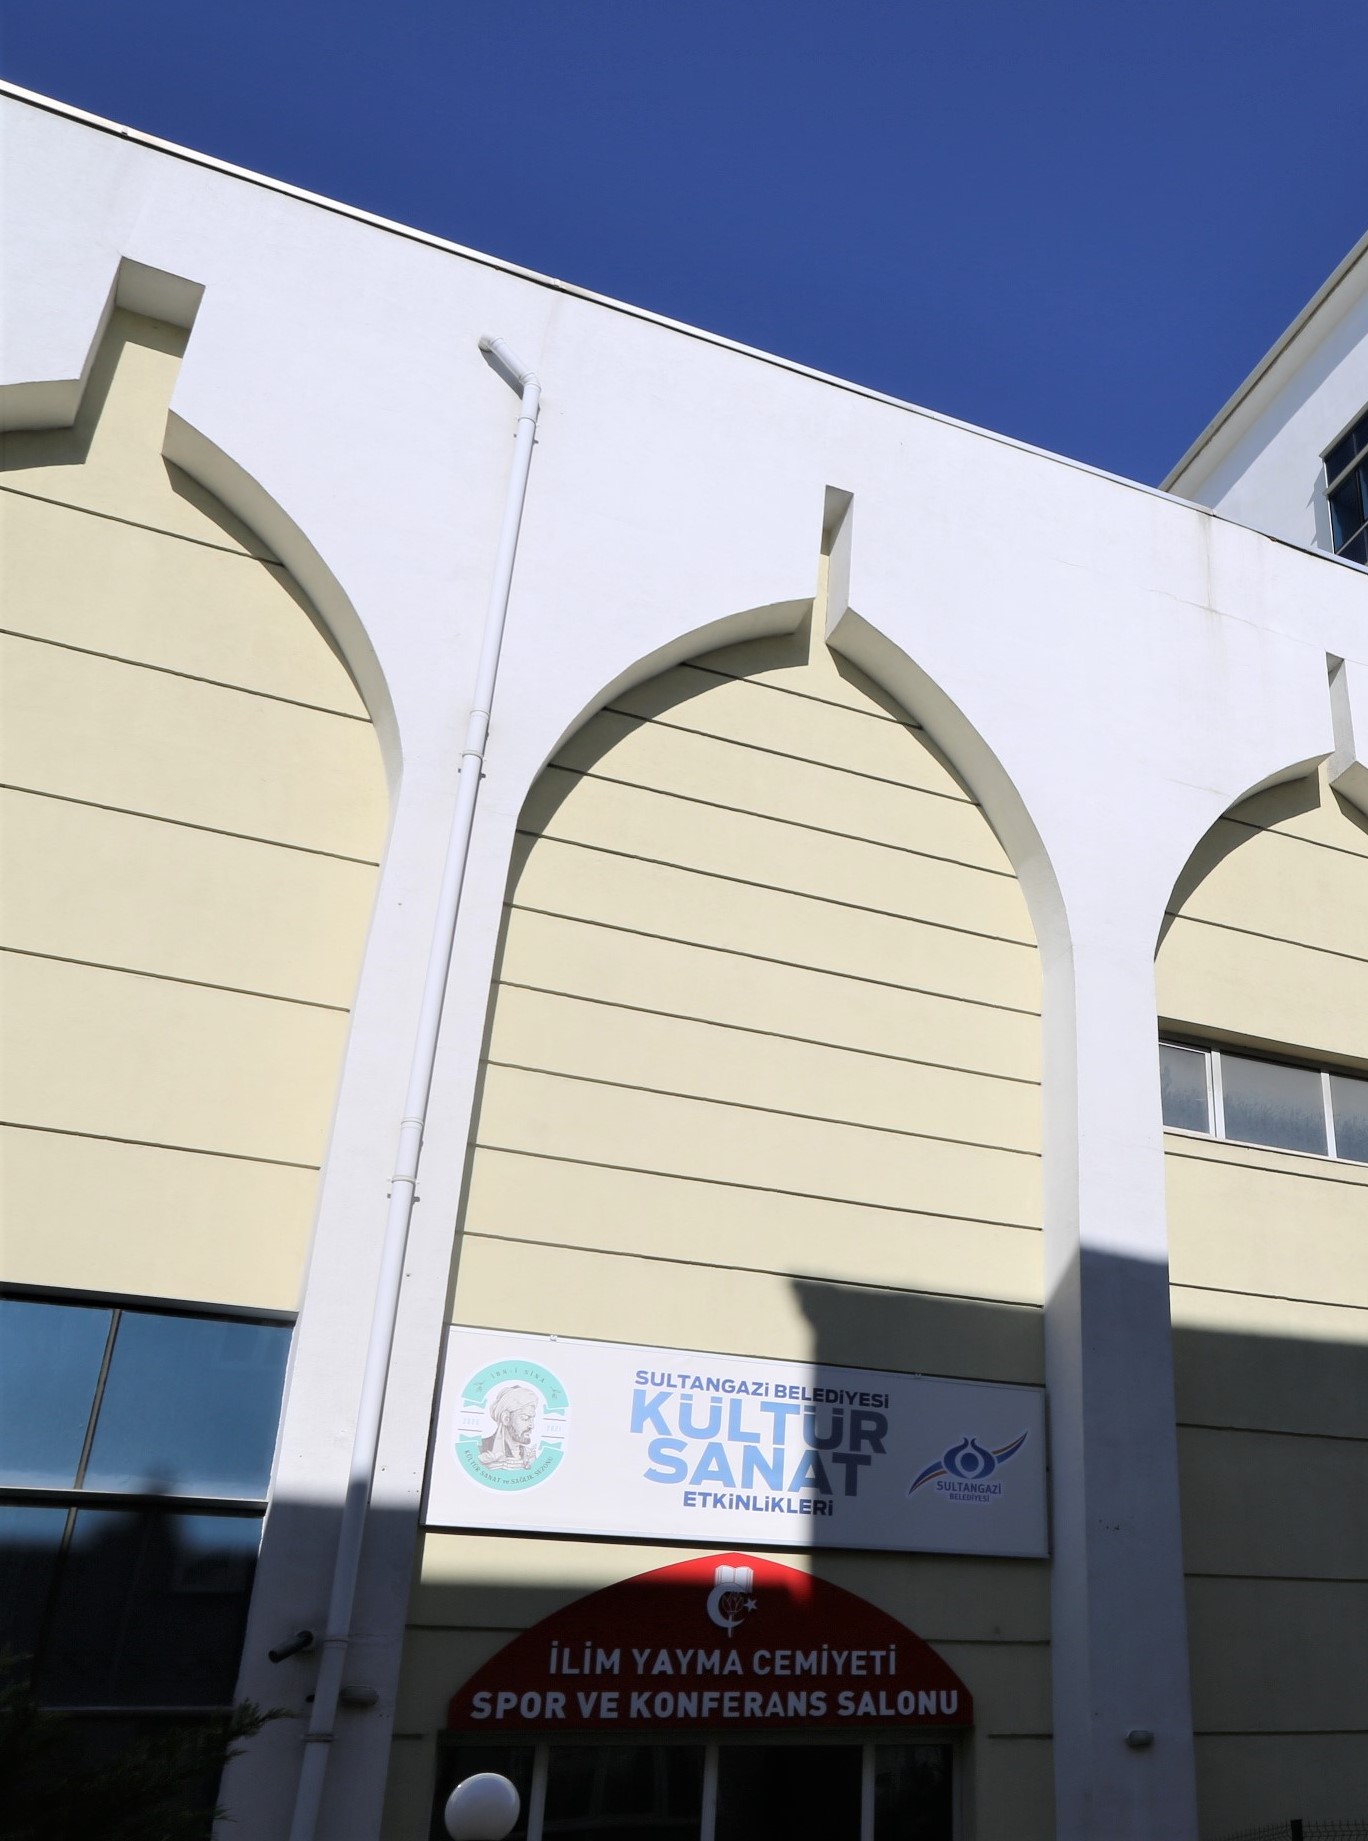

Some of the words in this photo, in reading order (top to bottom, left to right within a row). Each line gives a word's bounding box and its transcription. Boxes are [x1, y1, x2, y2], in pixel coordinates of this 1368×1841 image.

[630, 1388, 889, 1454] KÜLTÜR
[643, 1437, 872, 1497] SANAT
[936, 1480, 1002, 1495] SULTANGAZİ
[549, 1640, 621, 1675] İLİM
[632, 1648, 744, 1676] YAYMA
[752, 1643, 897, 1676] CEMİYETİ
[470, 1691, 567, 1720] SPOR
[576, 1691, 619, 1719] VE
[629, 1691, 828, 1718] KONFERANS
[837, 1689, 958, 1717] SALONU
